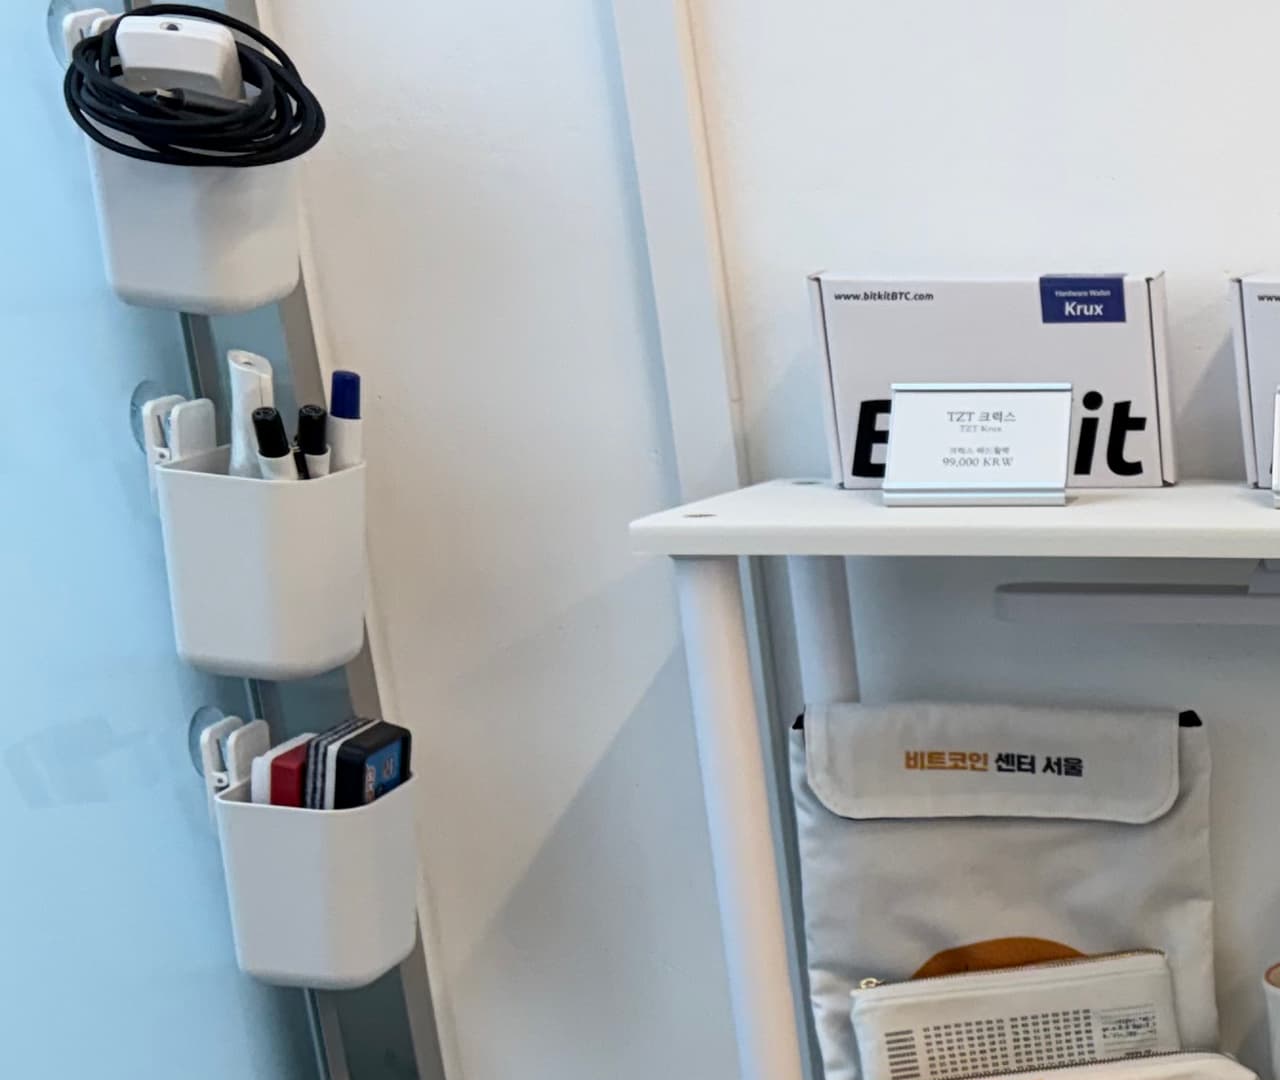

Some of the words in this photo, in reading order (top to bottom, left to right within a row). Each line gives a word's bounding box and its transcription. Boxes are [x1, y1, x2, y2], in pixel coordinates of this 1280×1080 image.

[834, 291, 934, 302] www.bitkitBTC.com
[1064, 301, 1104, 317] Krux
[946, 410, 976, 422] TZT
[978, 410, 1017, 423] 크럭스
[942, 457, 980, 468] 99,000
[983, 457, 1014, 467] KRW
[904, 749, 990, 772] 비트코인
[994, 752, 1036, 775] 센터
[1042, 755, 1084, 777] 서울
